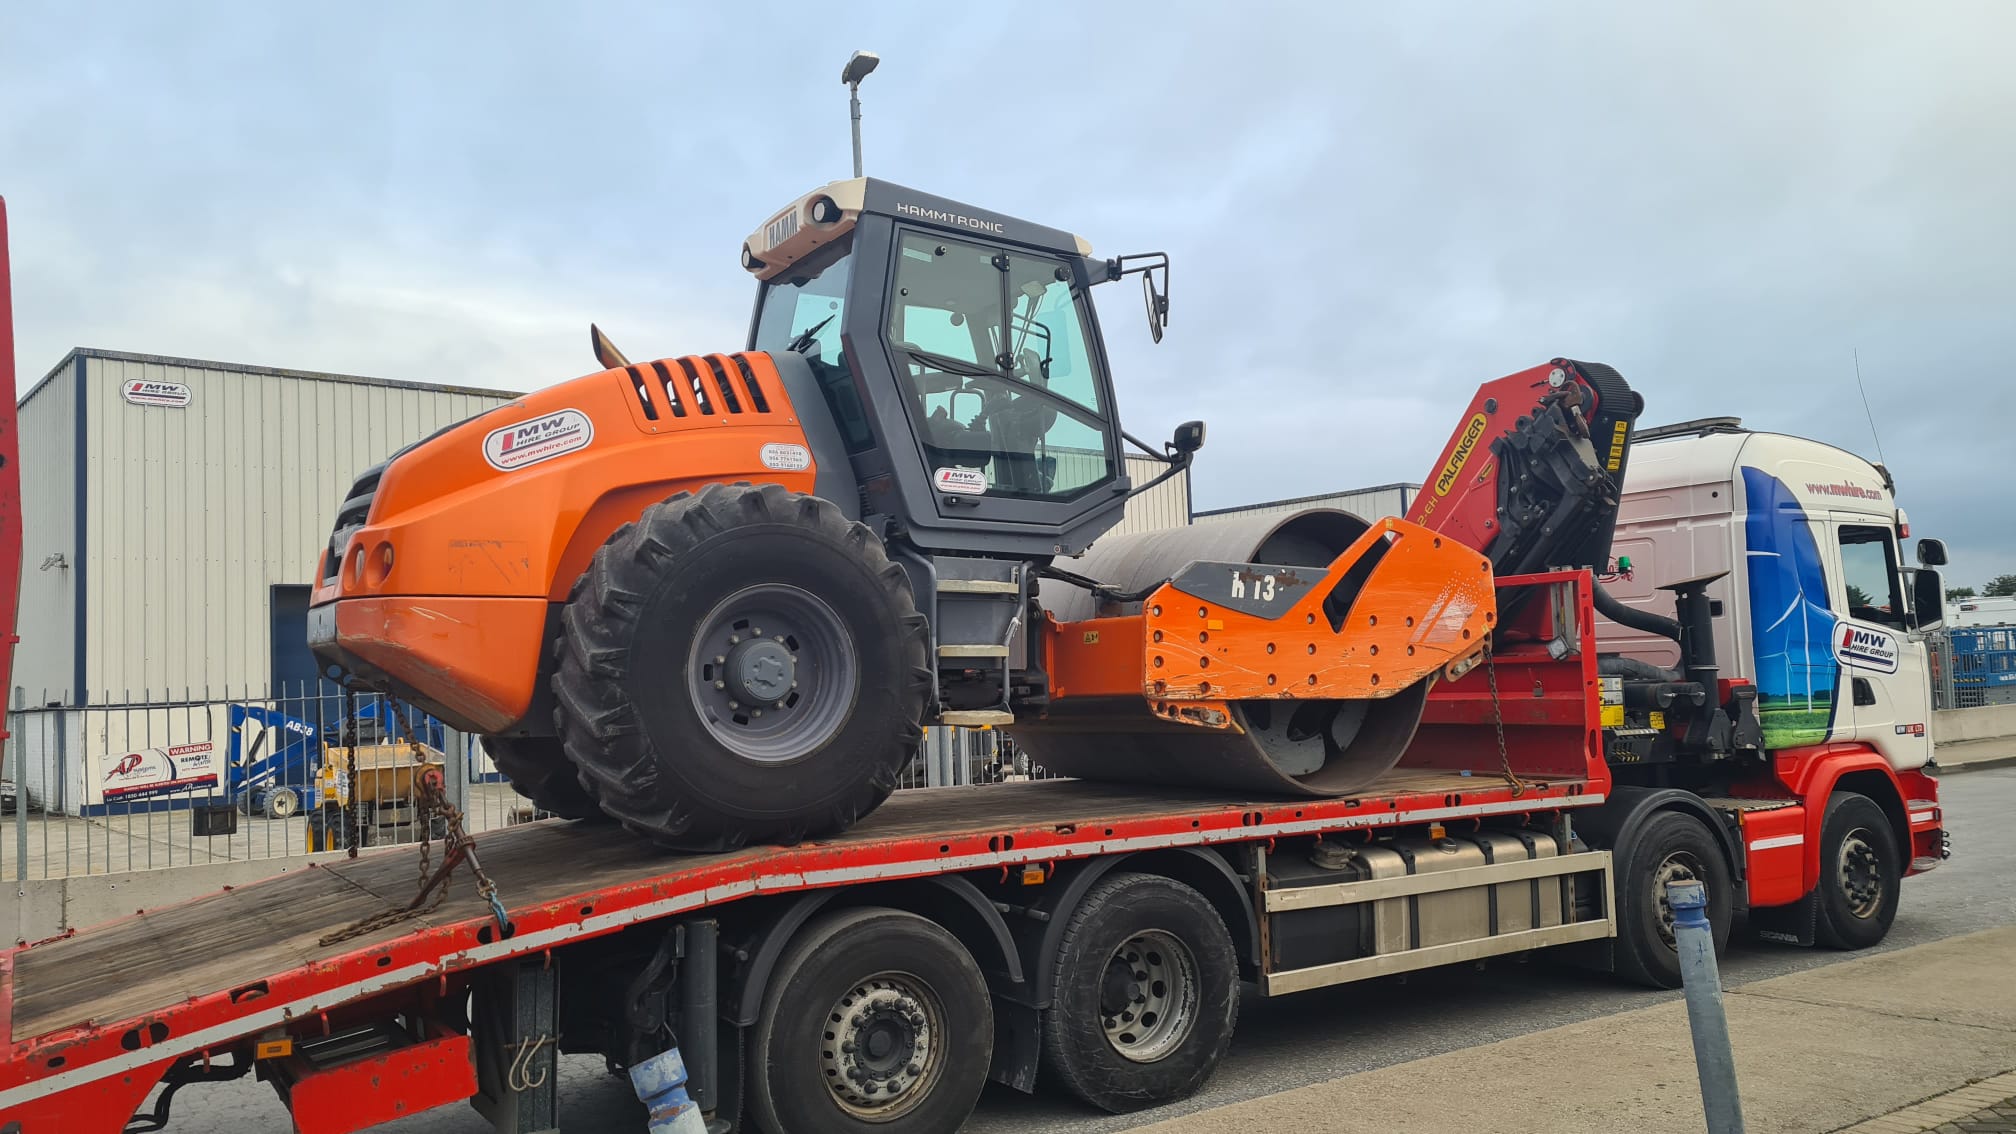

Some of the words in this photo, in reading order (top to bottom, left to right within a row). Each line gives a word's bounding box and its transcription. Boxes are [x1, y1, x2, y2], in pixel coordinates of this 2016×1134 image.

[897, 203, 1003, 232] HAMMTRONIC
[769, 210, 797, 249] HAMM
[516, 435, 541, 446] HIRE
[544, 423, 580, 438] GROUP
[517, 417, 564, 439] MW
[501, 436, 582, 464] www.mwhire.com
[1438, 418, 1485, 492] PALFINGER
[1805, 479, 1882, 500] www.mwhire.com
[1850, 643, 1869, 653] HIRE
[1869, 648, 1894, 658] GROUP
[1854, 631, 1887, 648] MW
[170, 744, 212, 756] WARNING
[180, 754, 208, 763] REMOTE
